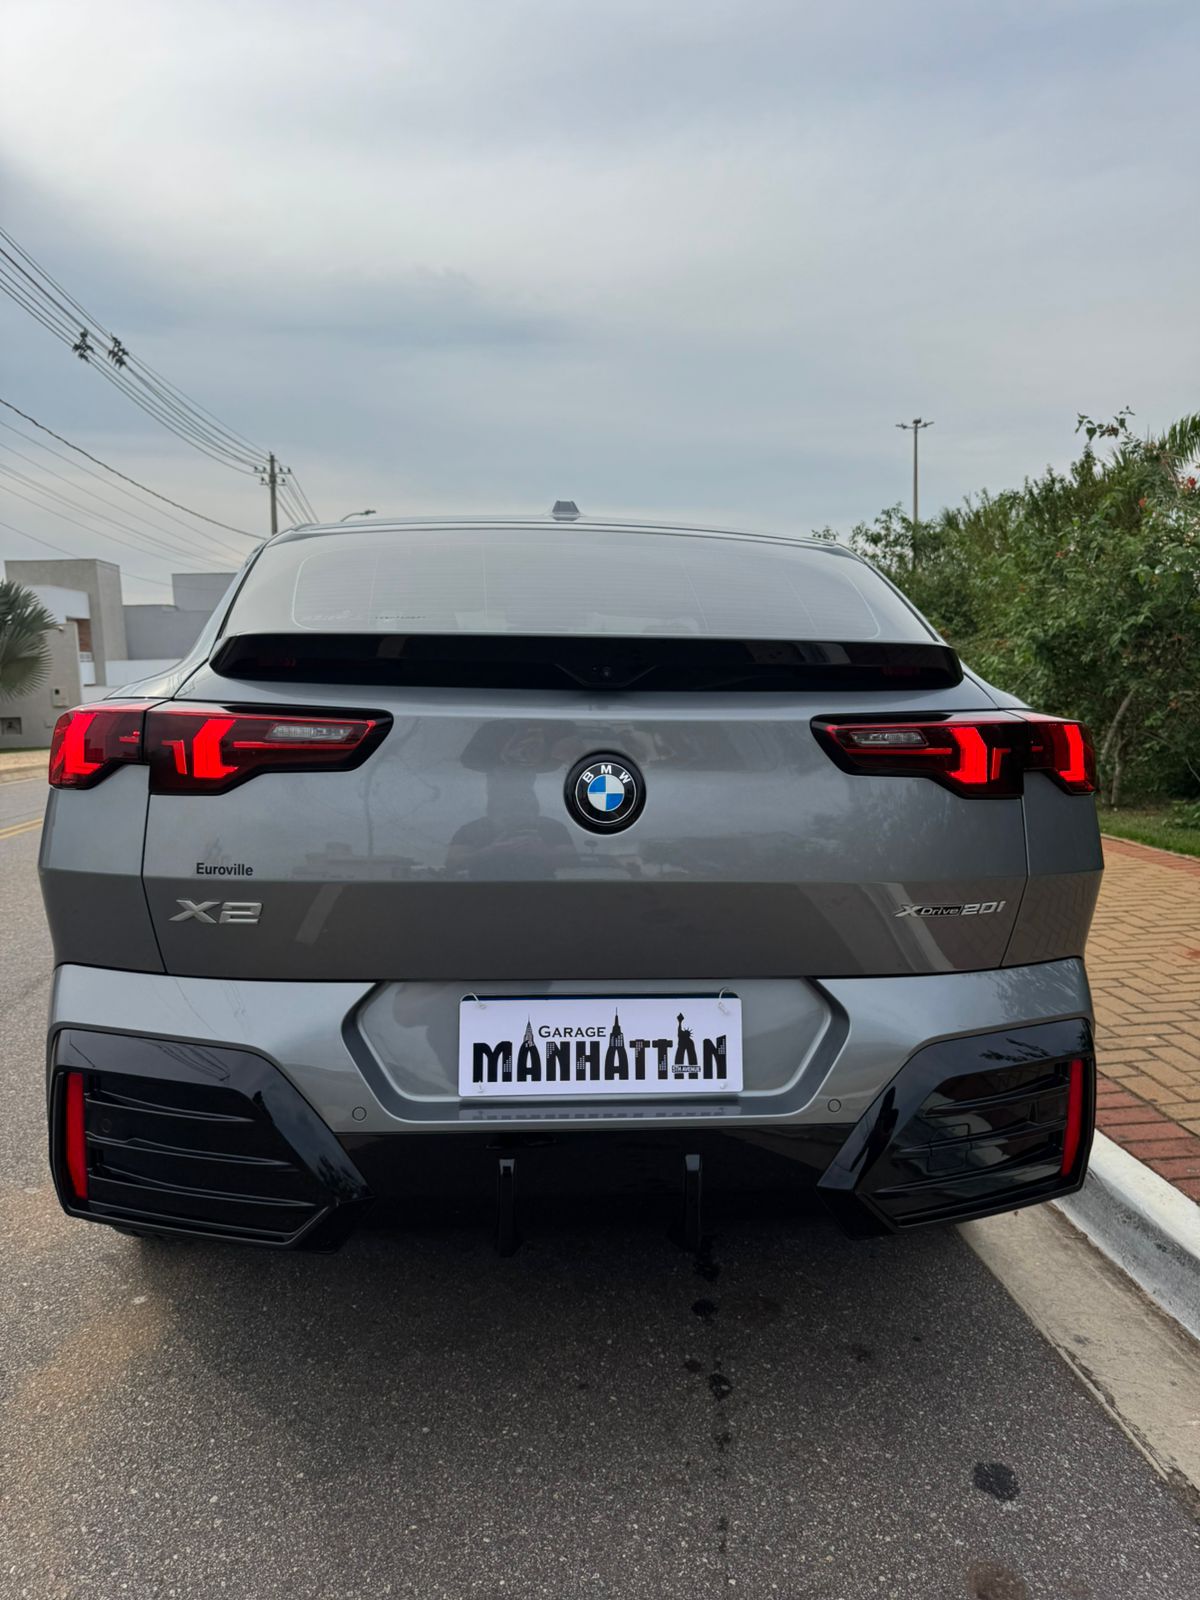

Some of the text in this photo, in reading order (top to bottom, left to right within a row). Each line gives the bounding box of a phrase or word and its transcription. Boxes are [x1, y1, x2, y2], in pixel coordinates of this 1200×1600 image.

[582, 765, 631, 784] BMW
[196, 862, 254, 876] Euroville
[168, 899, 263, 924] X2
[472, 1029, 727, 1083] MANHATTAN
